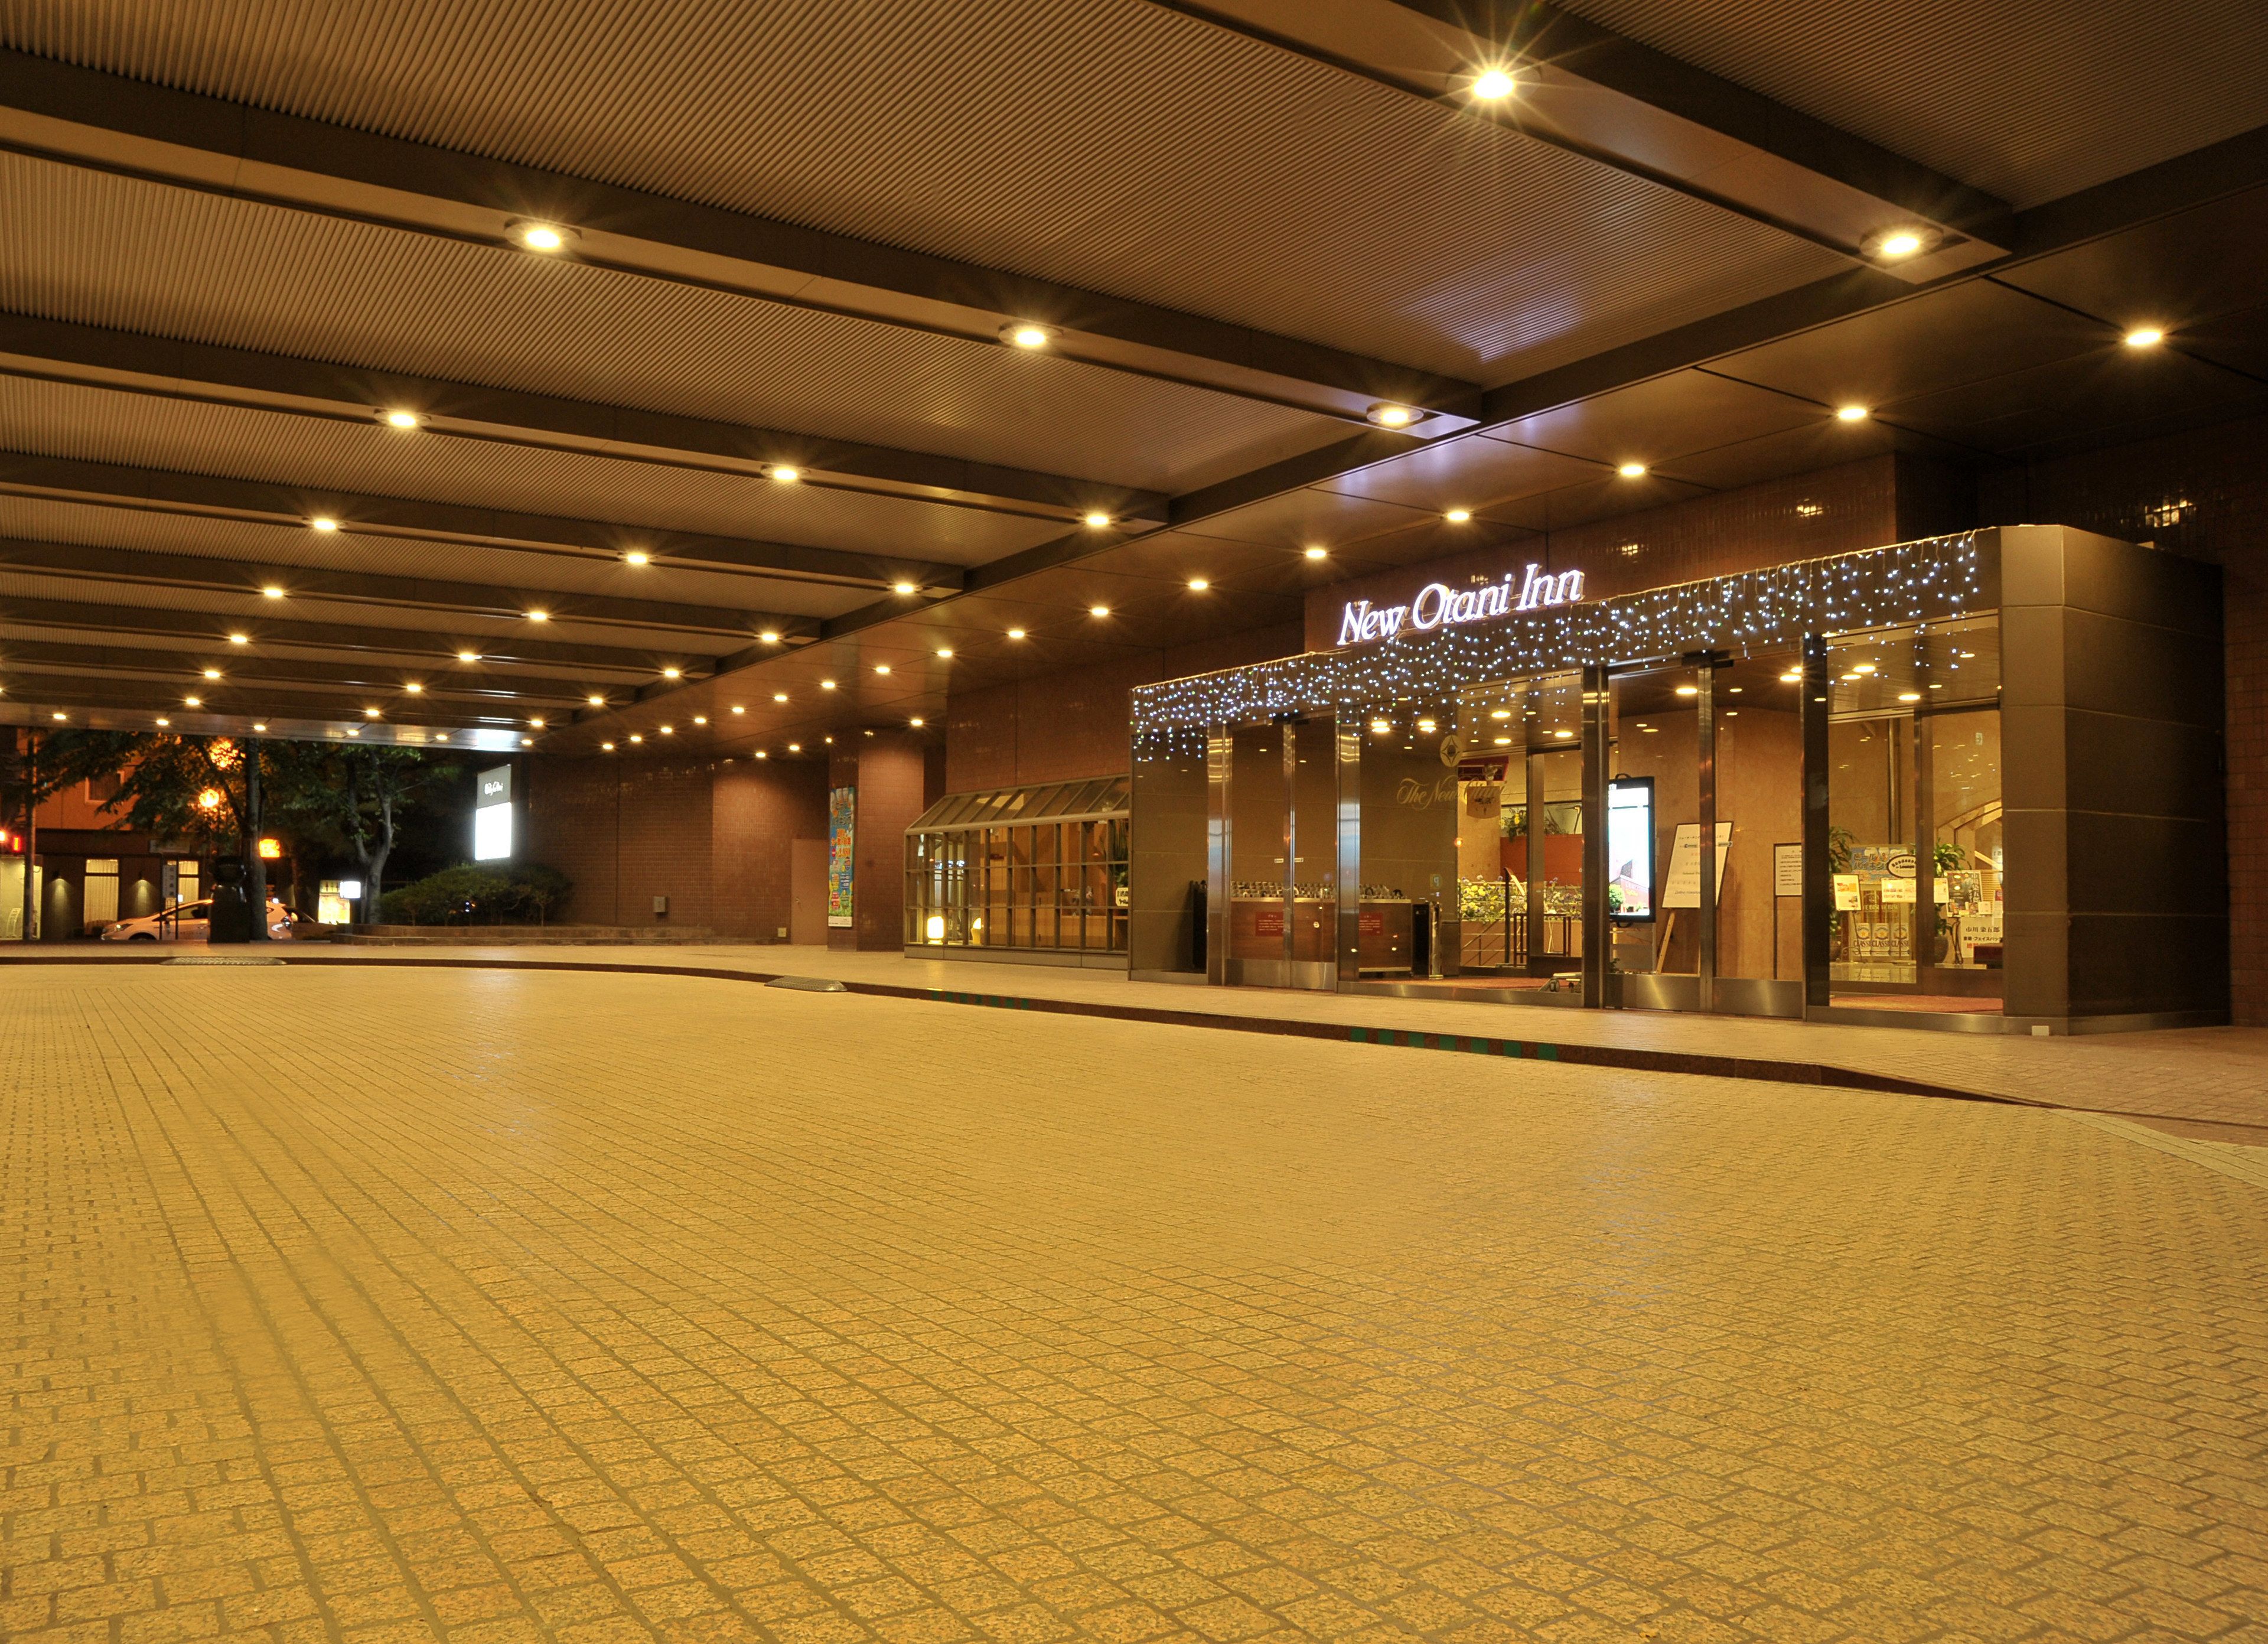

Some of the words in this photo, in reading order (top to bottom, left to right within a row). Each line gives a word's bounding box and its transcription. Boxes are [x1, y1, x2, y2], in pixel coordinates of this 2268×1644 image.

[1337, 601, 1406, 645] New
[1413, 573, 1513, 630] Otani
[1516, 563, 1582, 611] Inn
[1397, 777, 1429, 805] The
